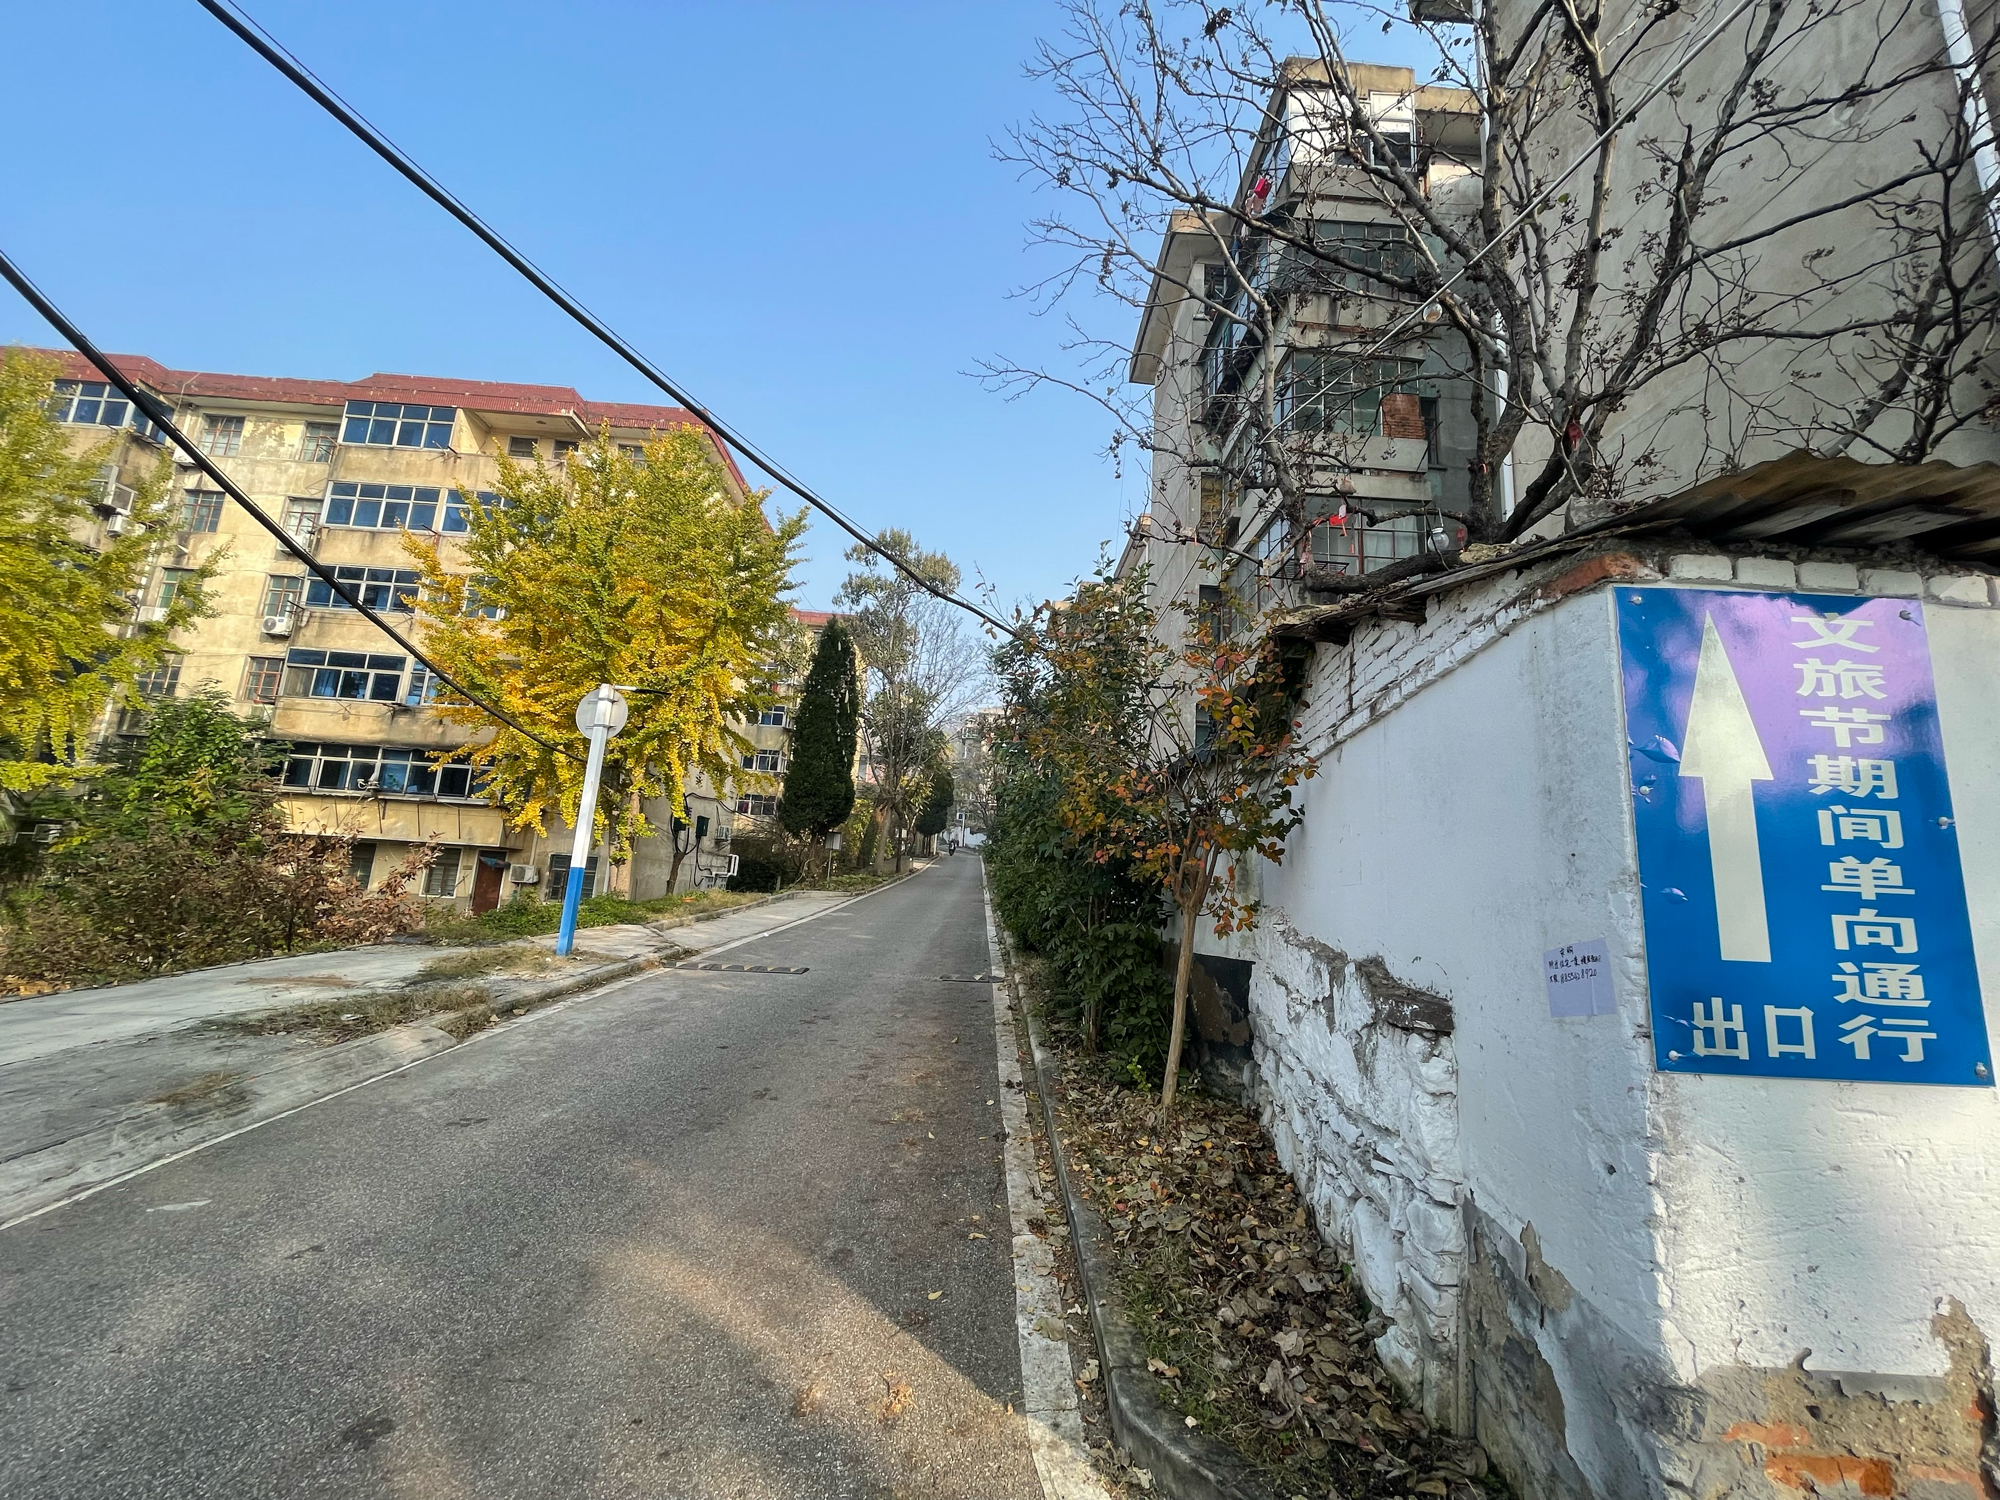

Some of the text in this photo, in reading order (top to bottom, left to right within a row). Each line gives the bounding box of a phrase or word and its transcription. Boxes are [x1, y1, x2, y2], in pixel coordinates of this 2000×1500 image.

[1791, 612, 1938, 1063] 文旅节期间单向通行
[1692, 997, 1817, 1061] 出口
